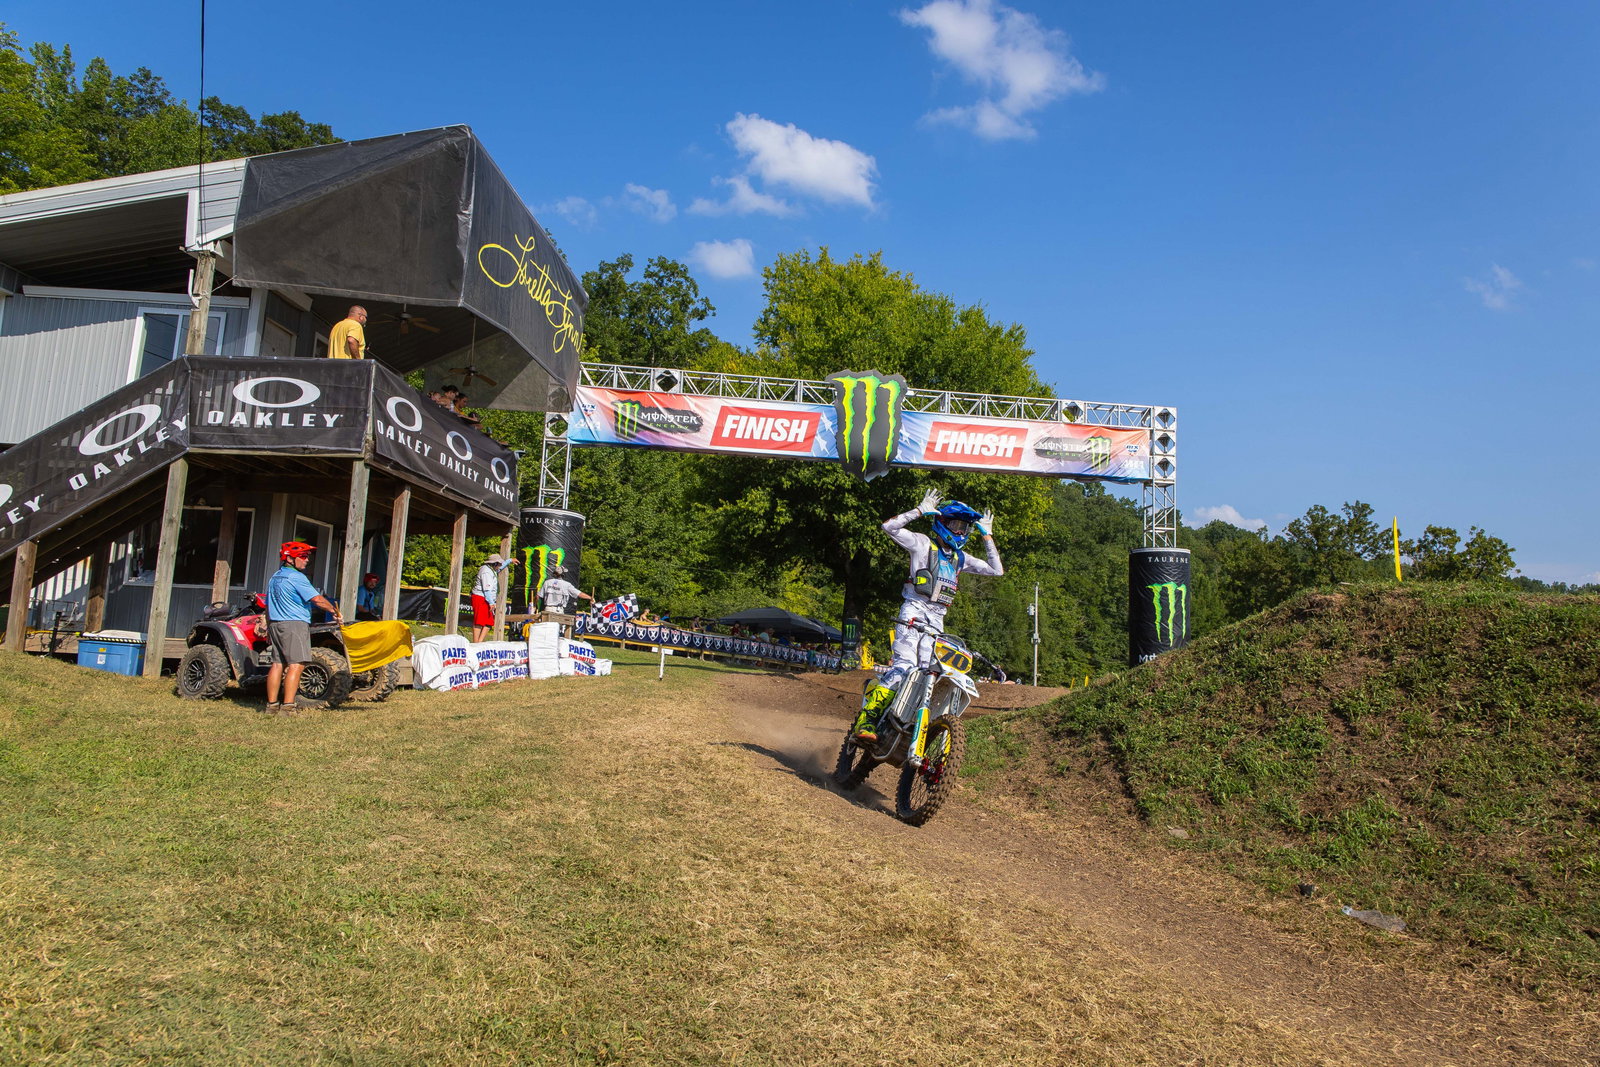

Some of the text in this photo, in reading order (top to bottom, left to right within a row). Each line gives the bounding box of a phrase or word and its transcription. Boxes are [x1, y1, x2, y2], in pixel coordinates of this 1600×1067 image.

[207, 410, 340, 428] OAKLEY
[641, 411, 698, 425] MONSTER
[721, 414, 810, 443] FINISH
[376, 419, 432, 457] OAKLEY
[933, 429, 1017, 458] FINISH
[68, 414, 188, 491] OAKLEY
[440, 452, 479, 483] OAKLEY
[484, 477, 514, 502] OAKLEY
[0, 494, 42, 532] EY
[524, 517, 571, 526] TAURINE
[1147, 556, 1188, 564] TAURINE
[568, 644, 597, 659] PARTS
[940, 646, 969, 671] 70
[449, 672, 473, 688] PARTS
[476, 669, 499, 683] PARTS
